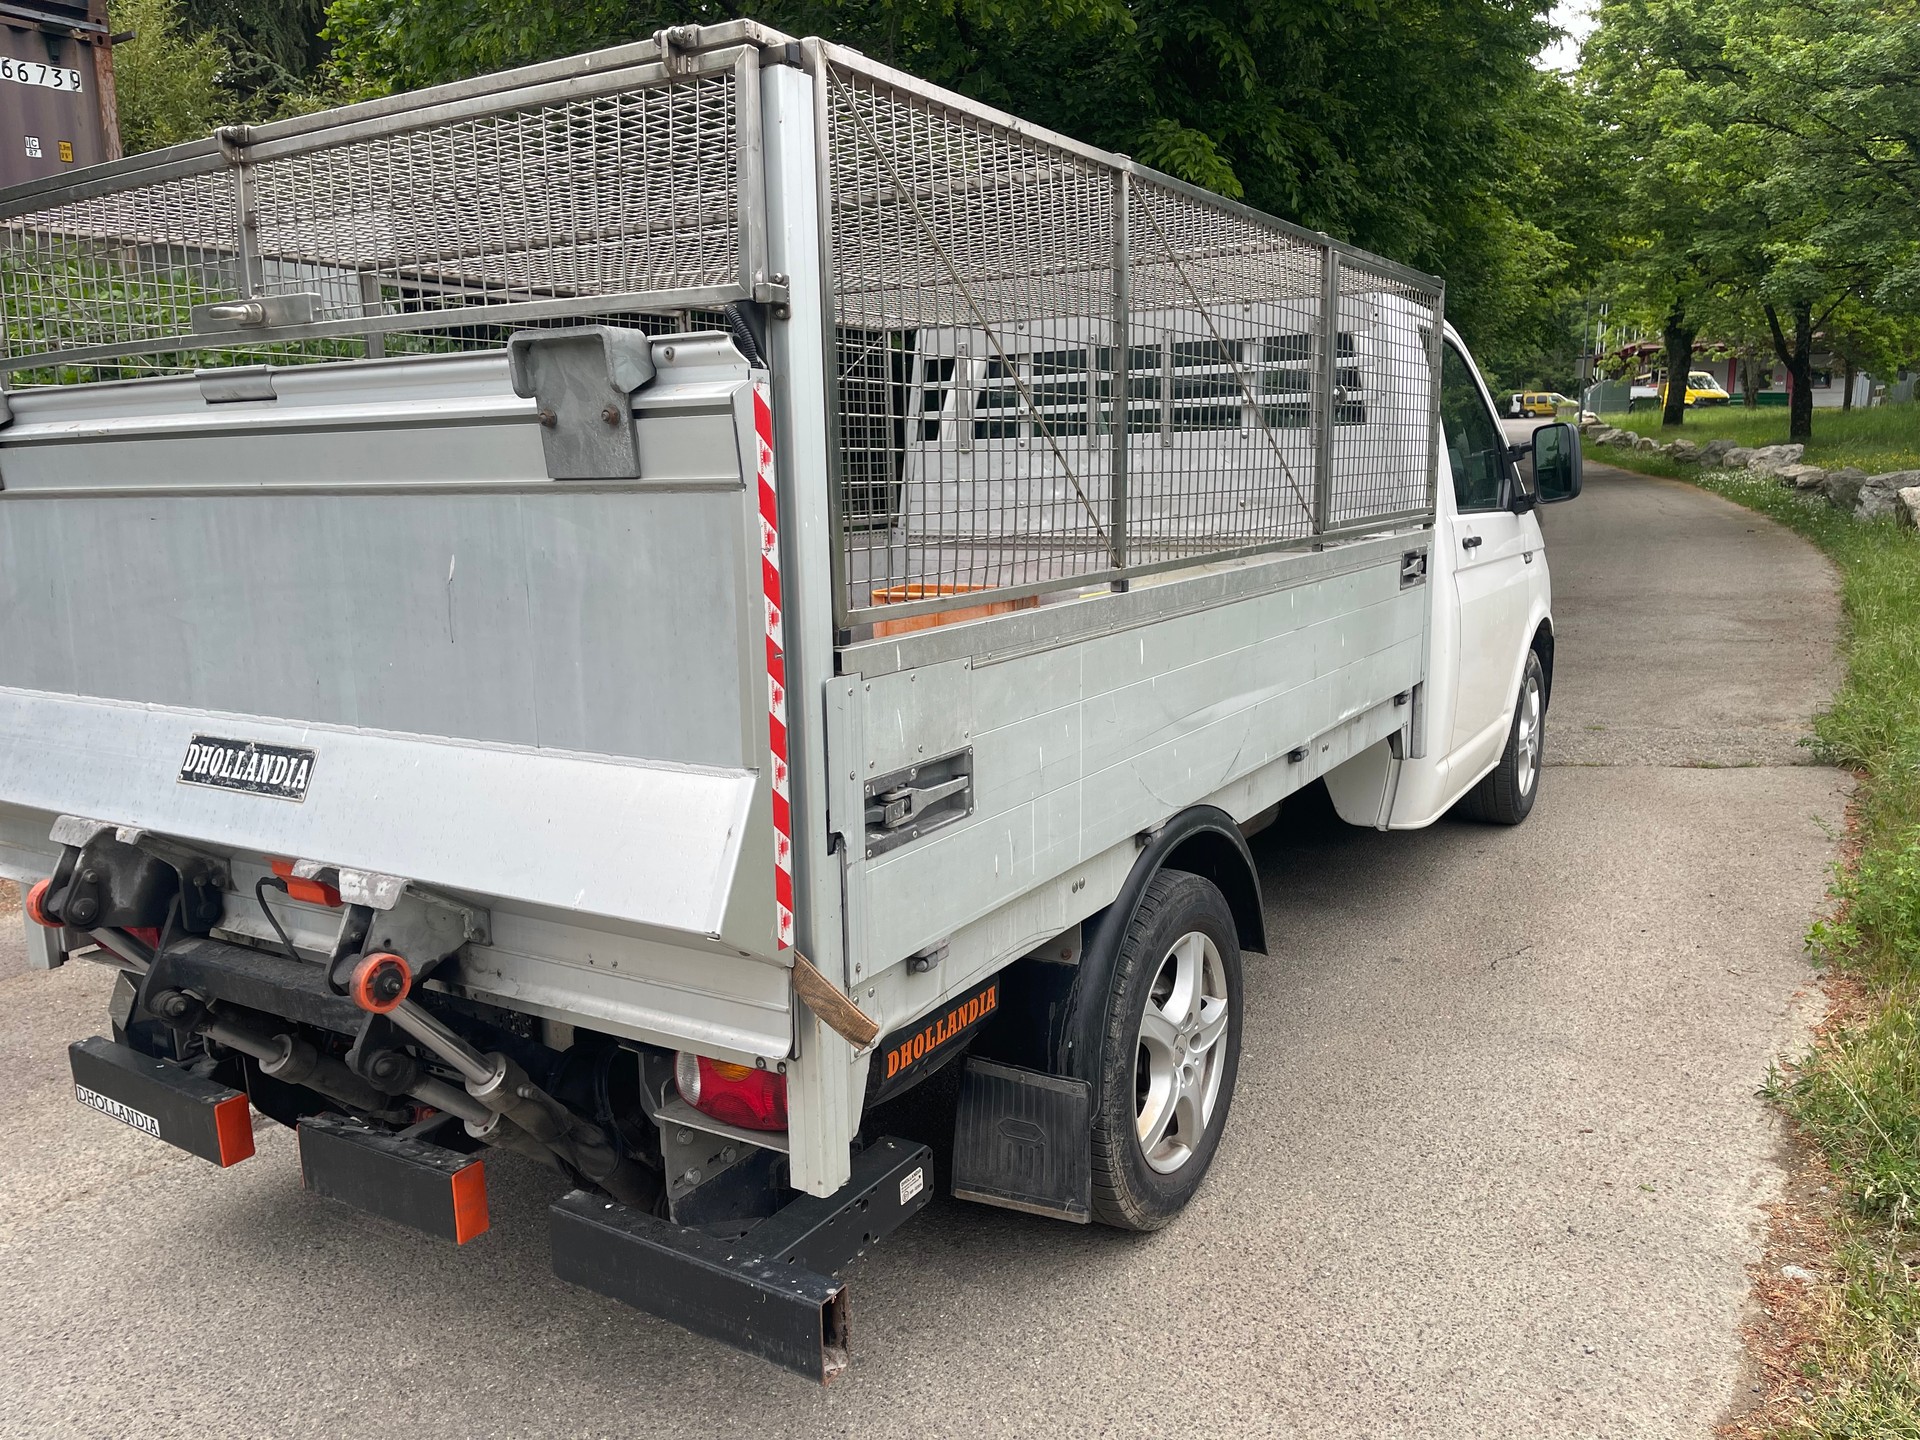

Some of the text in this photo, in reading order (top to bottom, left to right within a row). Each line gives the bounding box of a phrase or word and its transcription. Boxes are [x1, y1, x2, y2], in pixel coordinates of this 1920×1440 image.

[2, 60, 81, 89] 66739
[183, 744, 309, 788] DHOLLANDIA
[886, 985, 996, 1079] DHOLLANDIA
[77, 1086, 159, 1136] DHOLLANDIA
